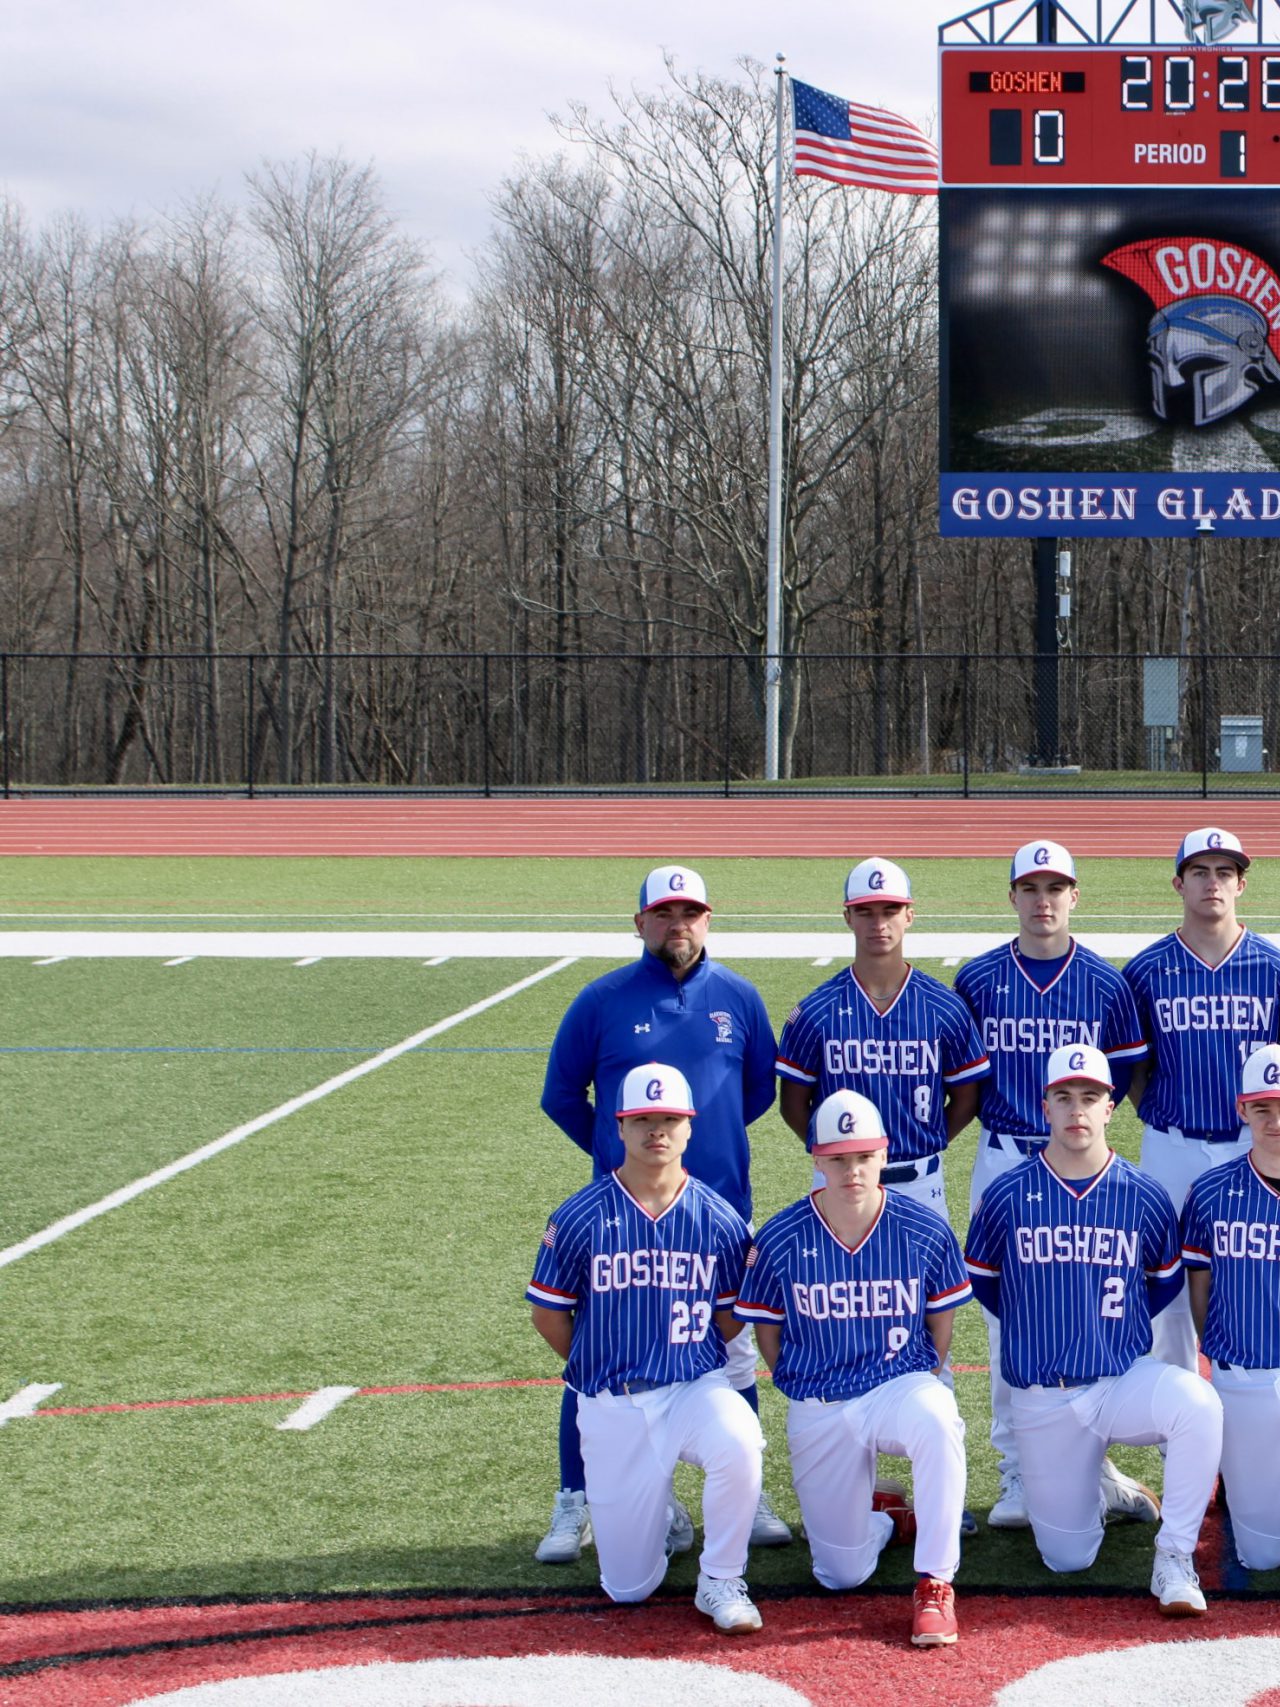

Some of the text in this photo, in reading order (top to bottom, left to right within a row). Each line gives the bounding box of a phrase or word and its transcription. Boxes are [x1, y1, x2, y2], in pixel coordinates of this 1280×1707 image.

[990, 72, 1062, 92] GOSHEN
[1034, 110, 1064, 164] 0
[1134, 143, 1206, 165] PERIOD
[1239, 135, 1246, 173] 1
[952, 488, 1136, 521] GOSHEN
[1033, 847, 1051, 865] G
[1207, 833, 1223, 850] G
[669, 873, 686, 891] G
[868, 871, 886, 890] G
[1154, 995, 1274, 1033] GOSHEN
[983, 1017, 1100, 1053] GOSHEN
[825, 1039, 940, 1075] GOSHEN
[1069, 1052, 1086, 1071] G
[1264, 1063, 1280, 1085] G
[646, 1080, 665, 1100] G
[913, 1085, 931, 1123] 8
[838, 1112, 856, 1133] G
[1016, 1225, 1138, 1267] GOSHEN
[591, 1250, 718, 1292] GOSHEN
[792, 1278, 918, 1320] GOSHEN
[1101, 1276, 1125, 1318] 2
[670, 1301, 712, 1344] 23
